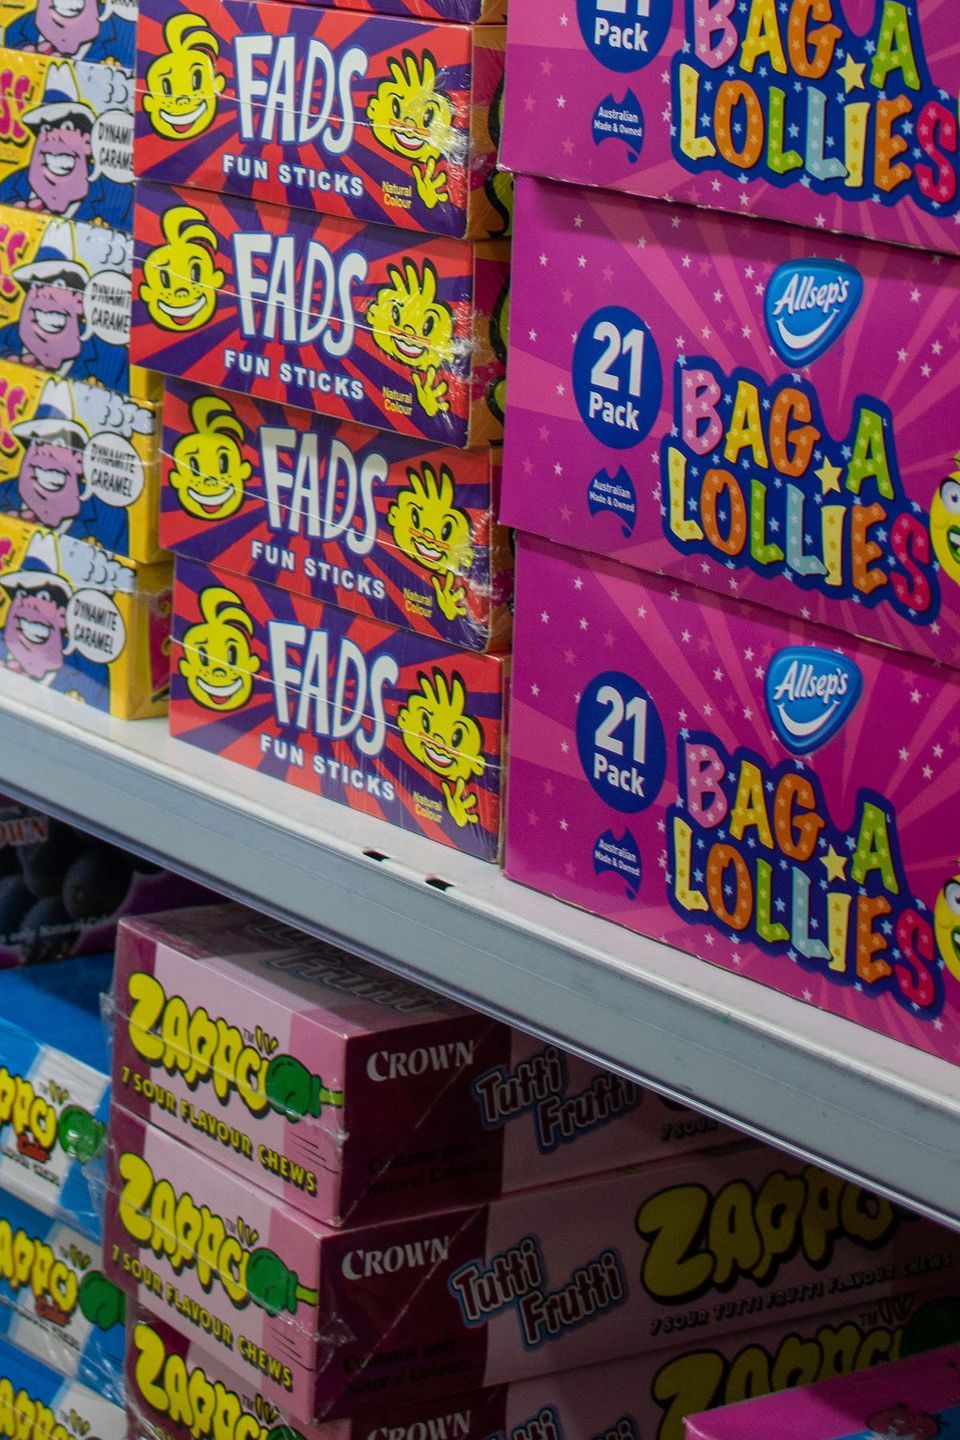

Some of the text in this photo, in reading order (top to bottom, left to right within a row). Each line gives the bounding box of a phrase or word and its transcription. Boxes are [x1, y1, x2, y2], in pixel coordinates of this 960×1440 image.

[594, 18, 649, 53] Pack
[869, 0, 921, 90] A
[234, 32, 369, 155] FADS
[598, 106, 639, 124] Australian
[594, 119, 613, 134] Made
[619, 123, 643, 137] Owned
[678, 63, 958, 203] LOLLIES
[222, 153, 365, 197] FUN STICKS
[381, 180, 413, 197] Natural
[383, 194, 413, 209] Colour
[233, 231, 368, 357] FADS
[773, 273, 849, 315] Allsep's
[223, 349, 366, 401] FUN STICKS
[591, 321, 645, 397] 21
[382, 385, 413, 404] Natural
[383, 399, 413, 416] Colour
[588, 391, 640, 431] Pack
[681, 369, 895, 500] BAG A
[91, 469, 133, 498] CARAMEL
[260, 425, 390, 555] FADS
[589, 491, 607, 506] Made
[613, 498, 636, 514] Owned
[593, 478, 632, 500] Australian
[667, 447, 932, 612] LOLLIES
[251, 540, 385, 600] FUN STICKS
[74, 597, 118, 632] DYNAMITE
[74, 625, 114, 655] CARAMEL
[268, 620, 399, 757] FADS
[774, 660, 848, 701] Allsep's
[594, 685, 648, 765] 21
[260, 735, 396, 802] FUN STICKS
[593, 756, 646, 798] Pack
[686, 742, 900, 895] BAG A
[674, 816, 936, 1007] LOLLIES
[128, 971, 270, 1112] ZAPPO
[366, 1040, 475, 1082] CROWN
[477, 1049, 563, 1122] Tutti
[539, 1073, 638, 1148] Frutti
[133, 1073, 176, 1112] SOUR
[180, 1099, 252, 1156] FLAVOUR
[257, 1144, 318, 1193] CHEWS
[118, 1152, 250, 1302] ZAPPO
[341, 1236, 452, 1280] CROWN
[453, 1240, 540, 1320] Tutti
[519, 1253, 624, 1344] Frutti
[123, 1253, 162, 1293] SOUR
[165, 1281, 233, 1345] FLAVOUR
[238, 1335, 294, 1389] CHEWS
